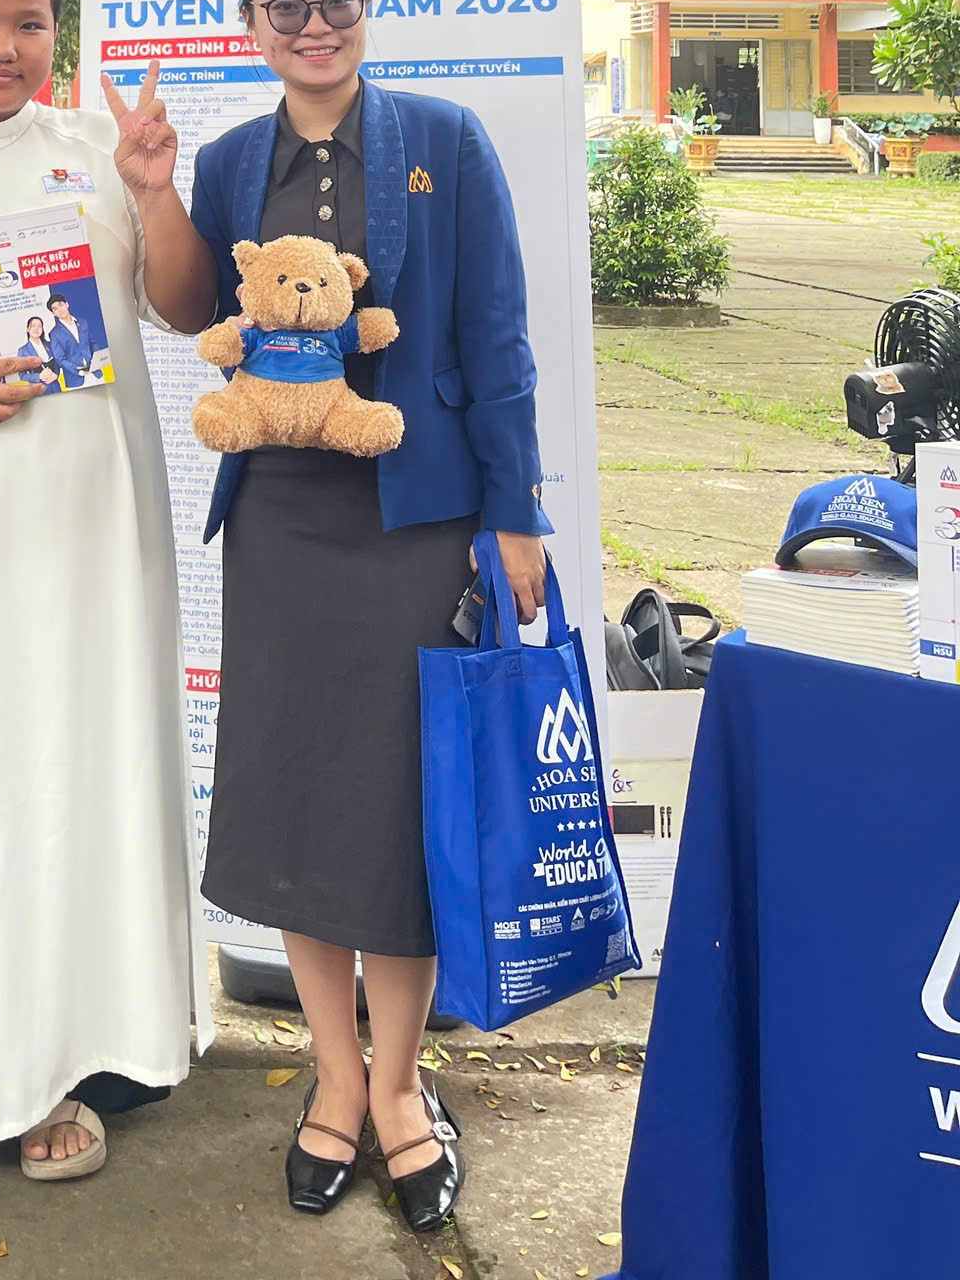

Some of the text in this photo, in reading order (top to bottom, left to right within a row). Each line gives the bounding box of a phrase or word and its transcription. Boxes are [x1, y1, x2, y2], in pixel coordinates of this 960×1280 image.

[106, 38, 224, 58] CHƯƠNG TRÌNH
[190, 71, 225, 82] TRÌNH
[388, 66, 415, 78] HỢP
[418, 63, 448, 75] MÔN
[451, 62, 476, 74] XÉT
[478, 60, 521, 73] TUYỂN
[189, 85, 214, 93] doanh
[21, 250, 70, 268] KHÁC BIỆT
[303, 337, 328, 356] 35
[827, 503, 889, 519] UNIVERSITY
[832, 495, 886, 510] HOA SEN
[933, 646, 953, 658] HSU
[191, 743, 215, 754] SAT
[536, 766, 597, 792] HOA SE
[529, 790, 600, 813] UNIVERS
[538, 839, 591, 864] World
[494, 921, 521, 930] MOET
[541, 915, 561, 926] STARS
